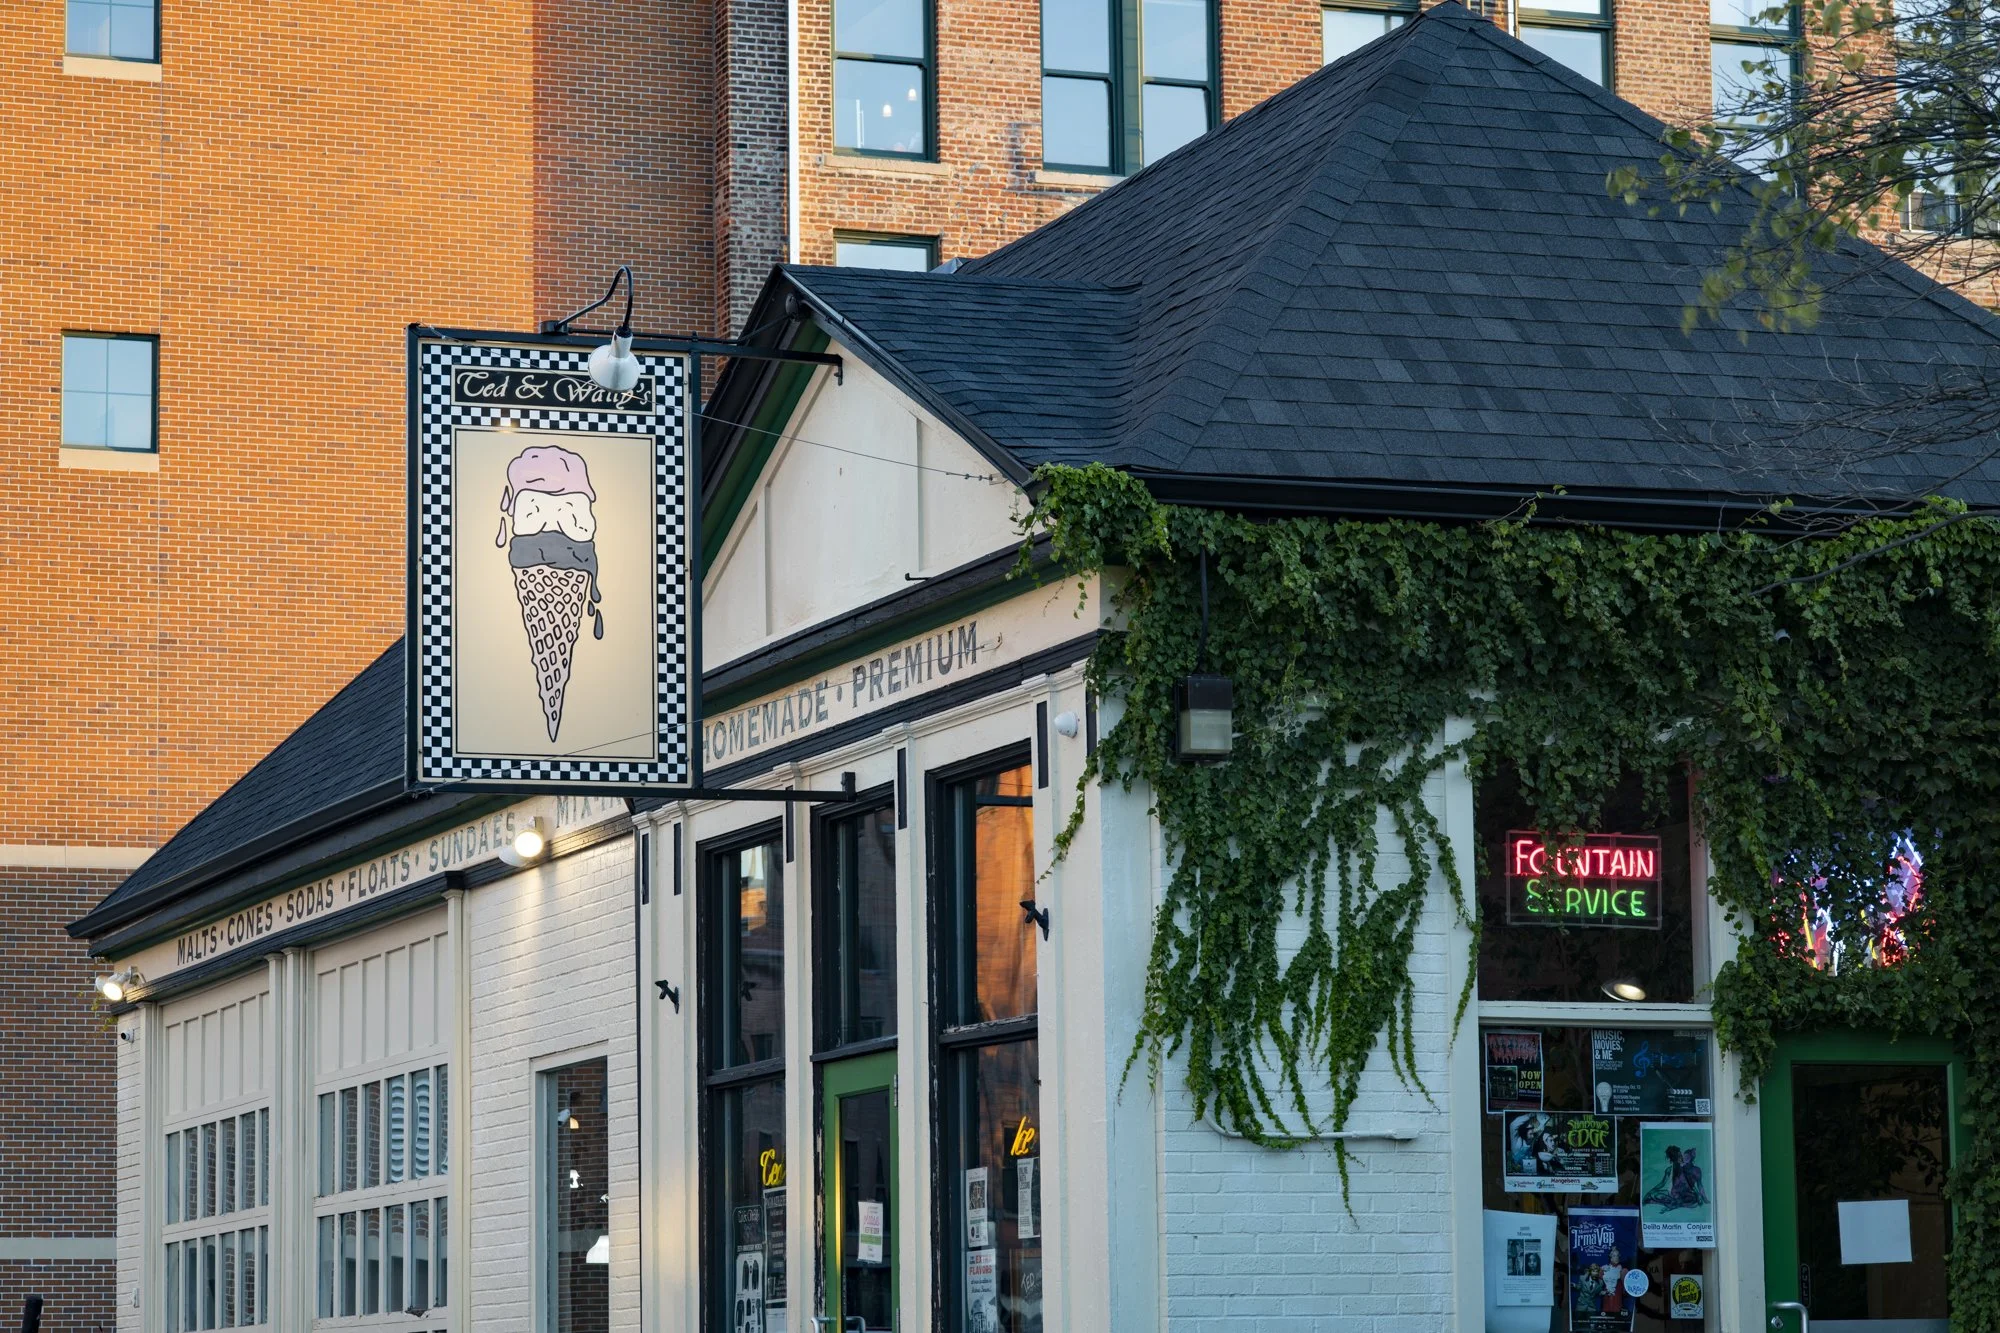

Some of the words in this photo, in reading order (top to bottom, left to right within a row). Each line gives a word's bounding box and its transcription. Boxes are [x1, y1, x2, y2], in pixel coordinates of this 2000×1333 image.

[457, 371, 510, 398] Ted
[515, 374, 549, 399] &
[852, 620, 978, 708] PREMIUM
[177, 925, 218, 966] MALTS
[228, 902, 274, 946] CONES
[286, 878, 334, 923] SODAS
[348, 850, 411, 902] FLOATS
[429, 811, 516, 873] SUNDAES
[1594, 1030, 1625, 1043] MUSIC,
[1595, 1040, 1623, 1053] MOVIES,
[1595, 1050, 1601, 1060] &
[1602, 1050, 1614, 1060] ME
[1521, 1070, 1542, 1080] NOW
[1519, 1081, 1542, 1090] OPEN
[1568, 1129, 1609, 1148] EDGE
[1687, 1223, 1712, 1231] Conjure
[1593, 1226, 1615, 1247] Vep
